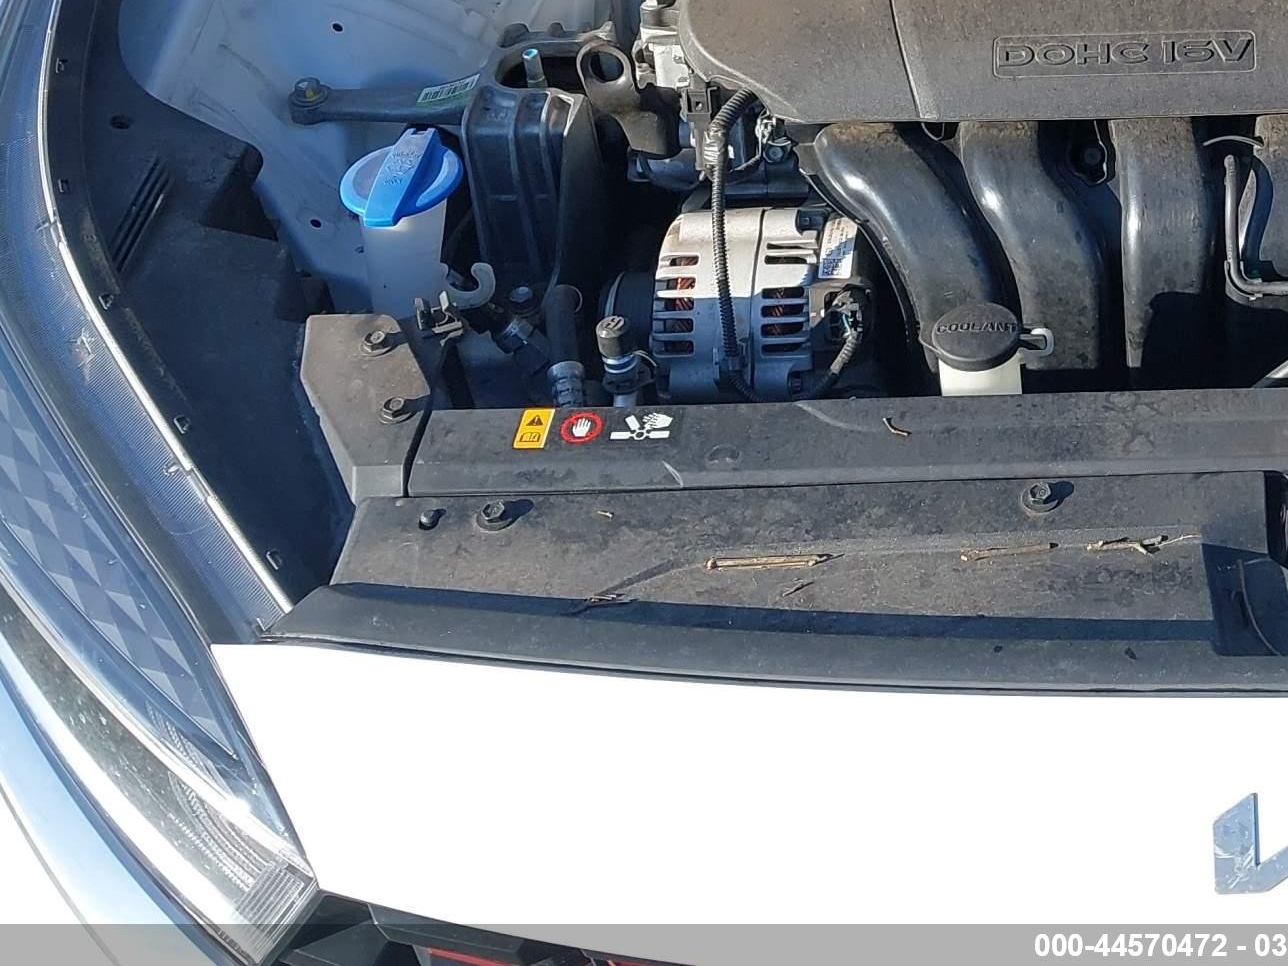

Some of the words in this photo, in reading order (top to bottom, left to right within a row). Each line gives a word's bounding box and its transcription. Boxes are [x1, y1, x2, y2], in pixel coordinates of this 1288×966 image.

[999, 41, 1149, 66] DOHC
[1161, 38, 1252, 64] 16V
[936, 321, 1018, 334] COOLANT
